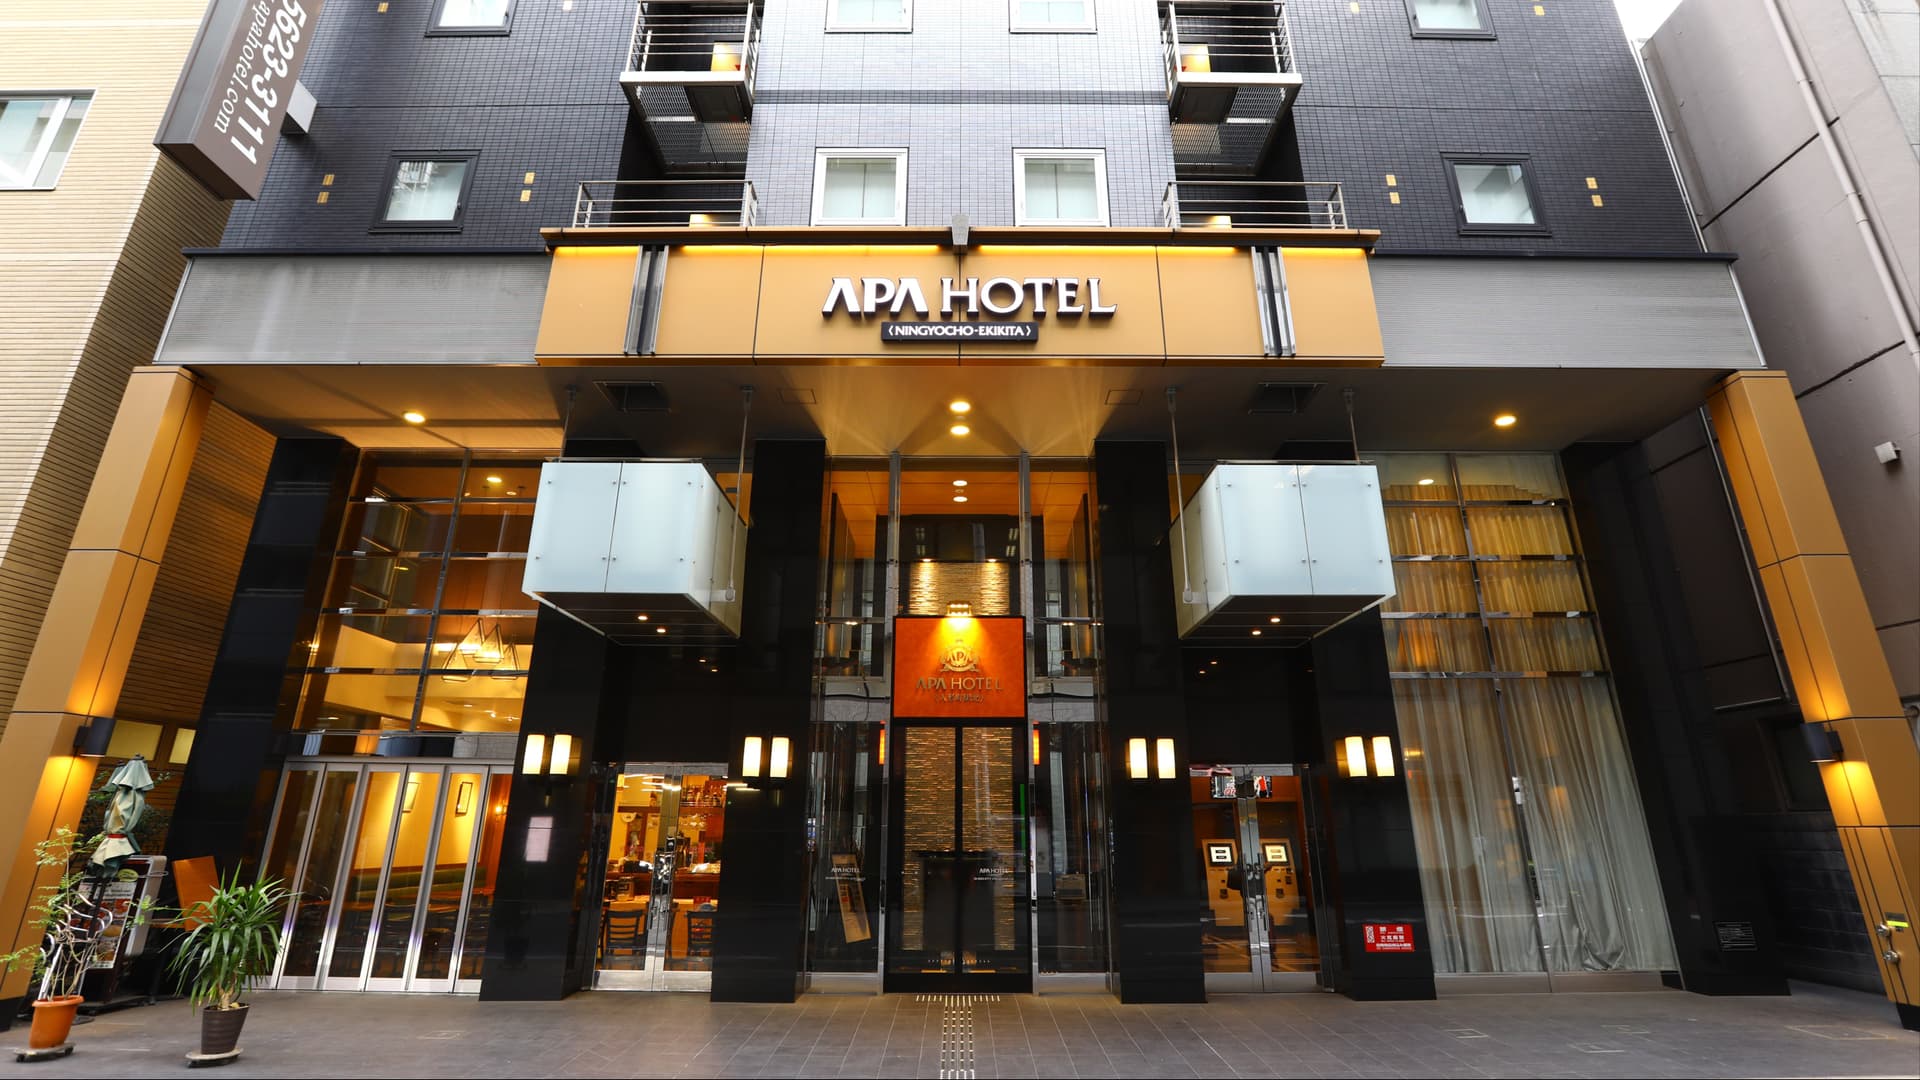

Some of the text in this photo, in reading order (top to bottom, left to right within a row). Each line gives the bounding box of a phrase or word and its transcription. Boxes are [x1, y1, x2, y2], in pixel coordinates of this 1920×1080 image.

[822, 277, 1117, 315] APA HOTEL
[915, 677, 1004, 690] APA HOTEL
